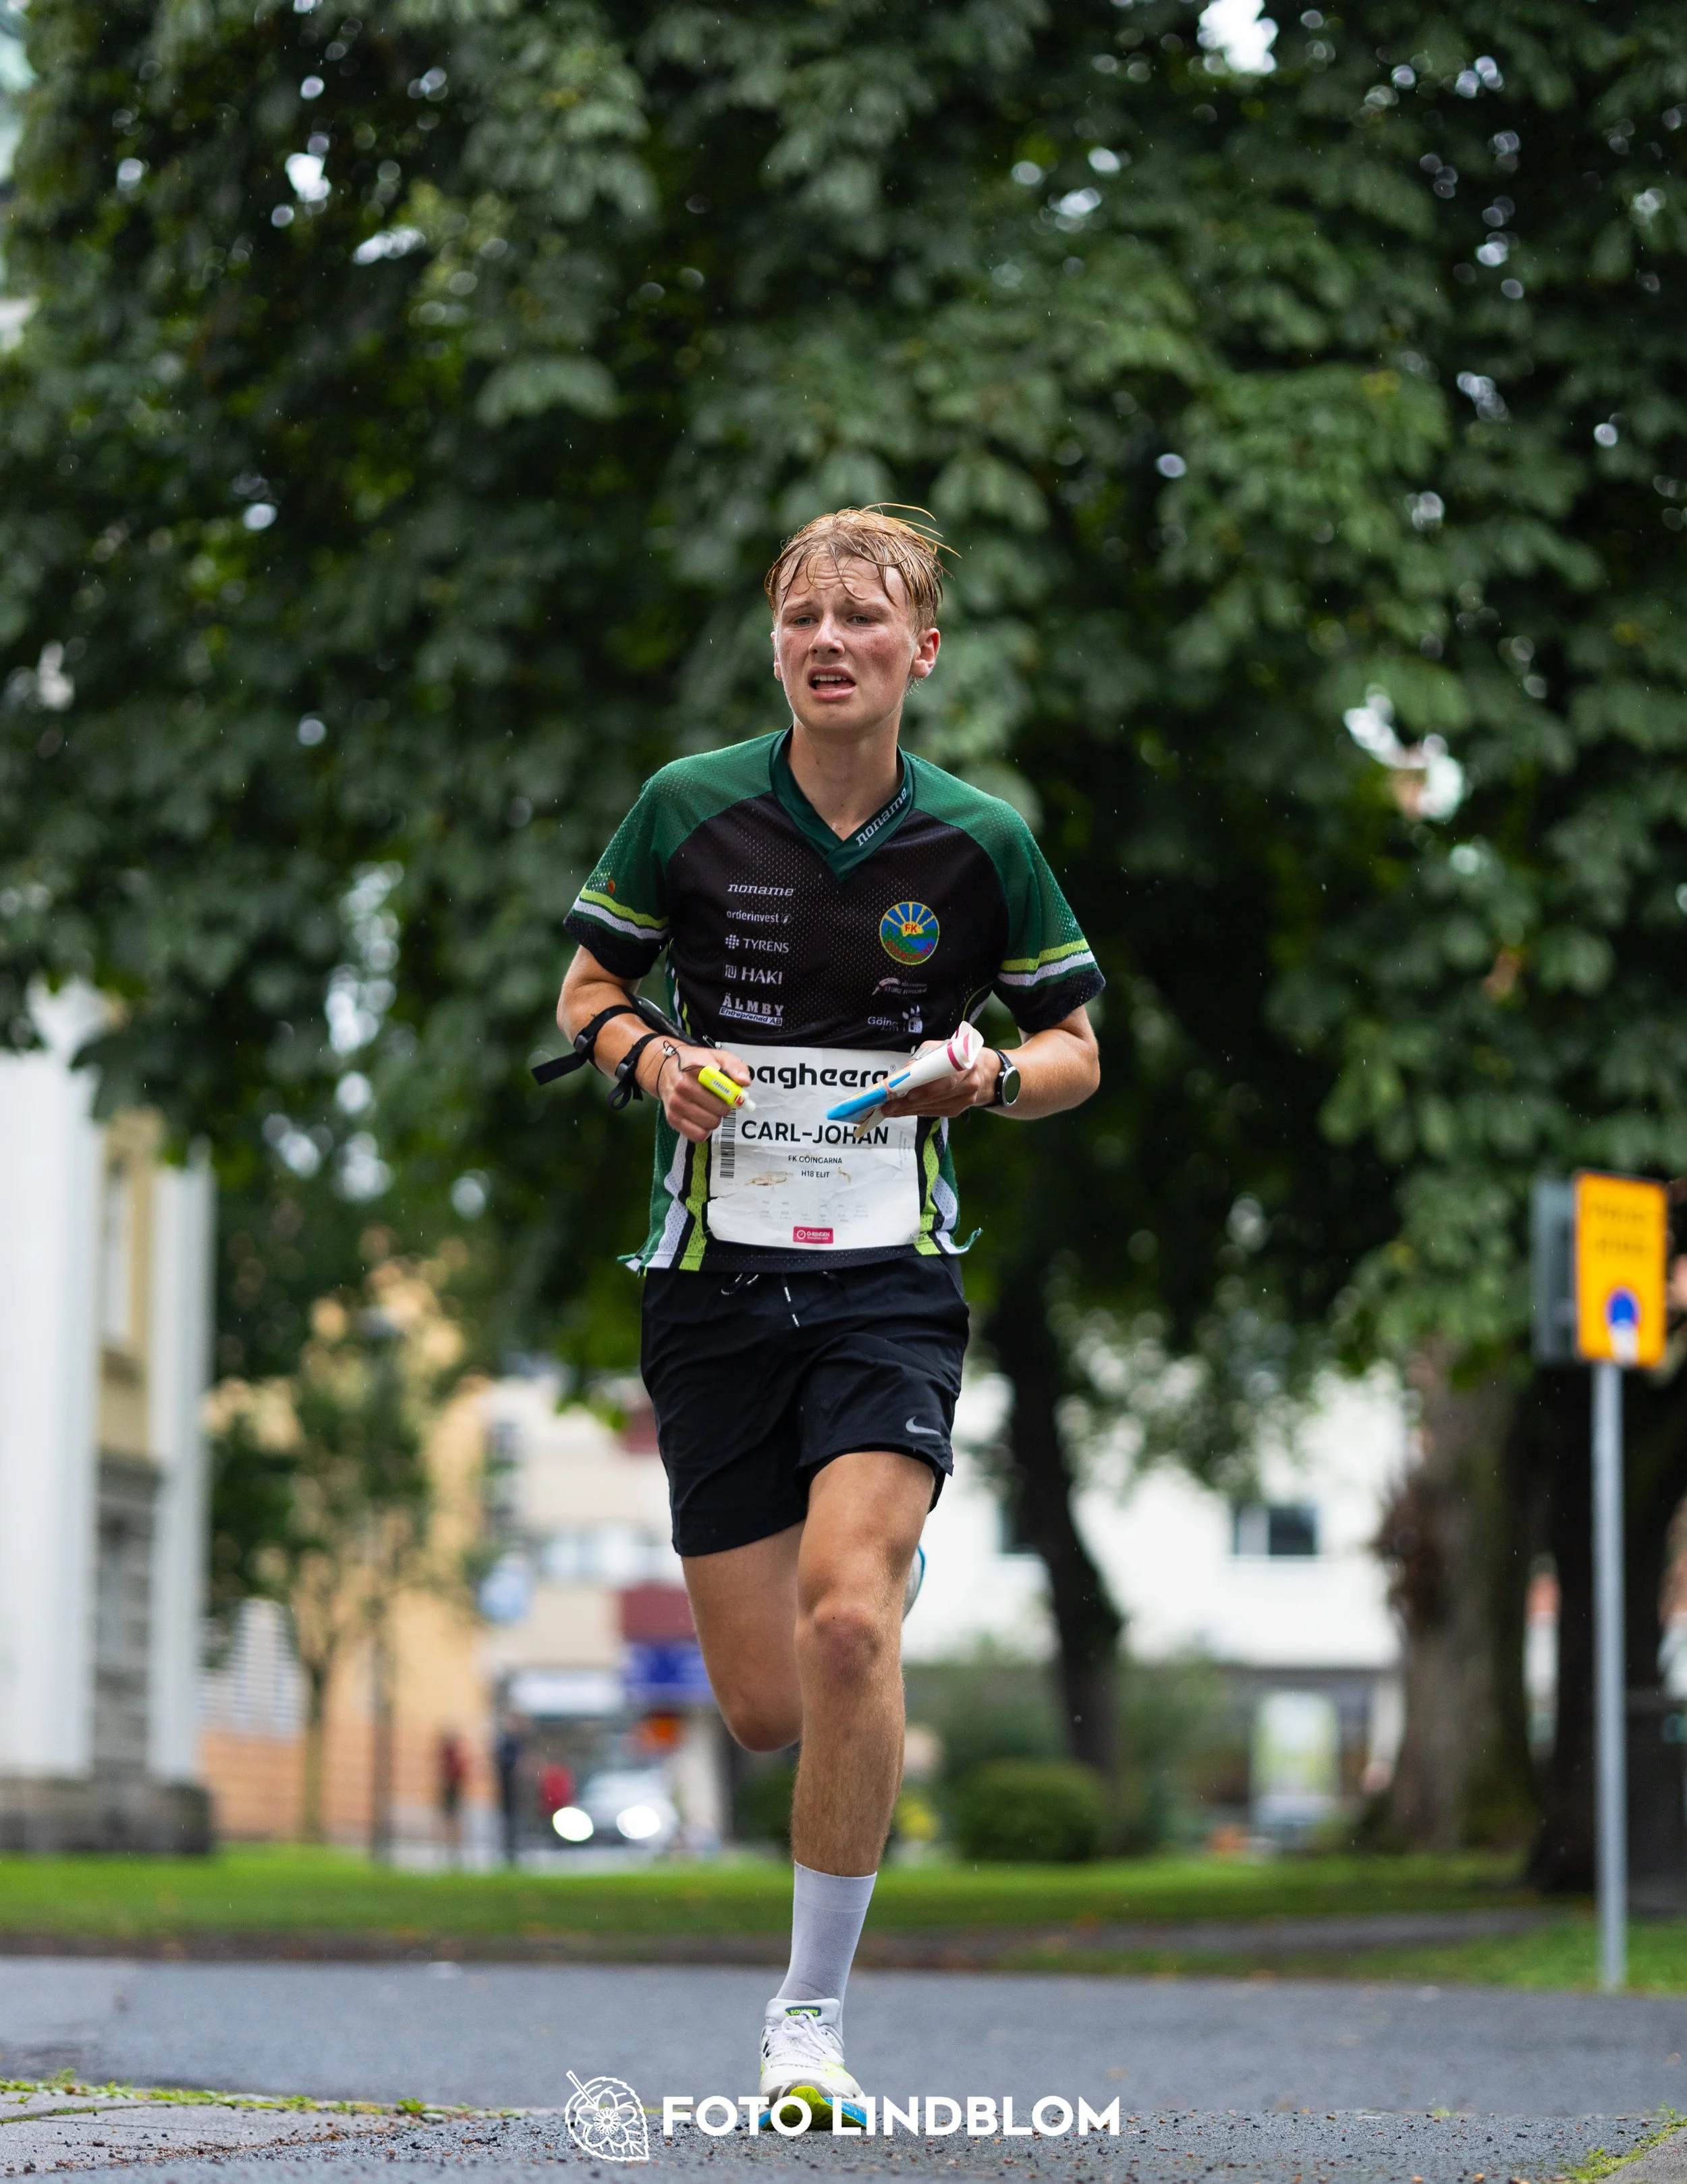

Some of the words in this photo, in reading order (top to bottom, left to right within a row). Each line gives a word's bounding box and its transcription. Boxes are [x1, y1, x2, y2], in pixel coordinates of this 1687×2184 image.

[856, 788, 907, 846] noname
[727, 884, 794, 896] noname
[727, 910, 779, 923] orderinvest
[905, 923, 917, 933] FK
[742, 966, 783, 985] HAKI
[723, 992, 784, 1016] ÄLMBY
[742, 1120, 889, 1144] CARL-JOHAN
